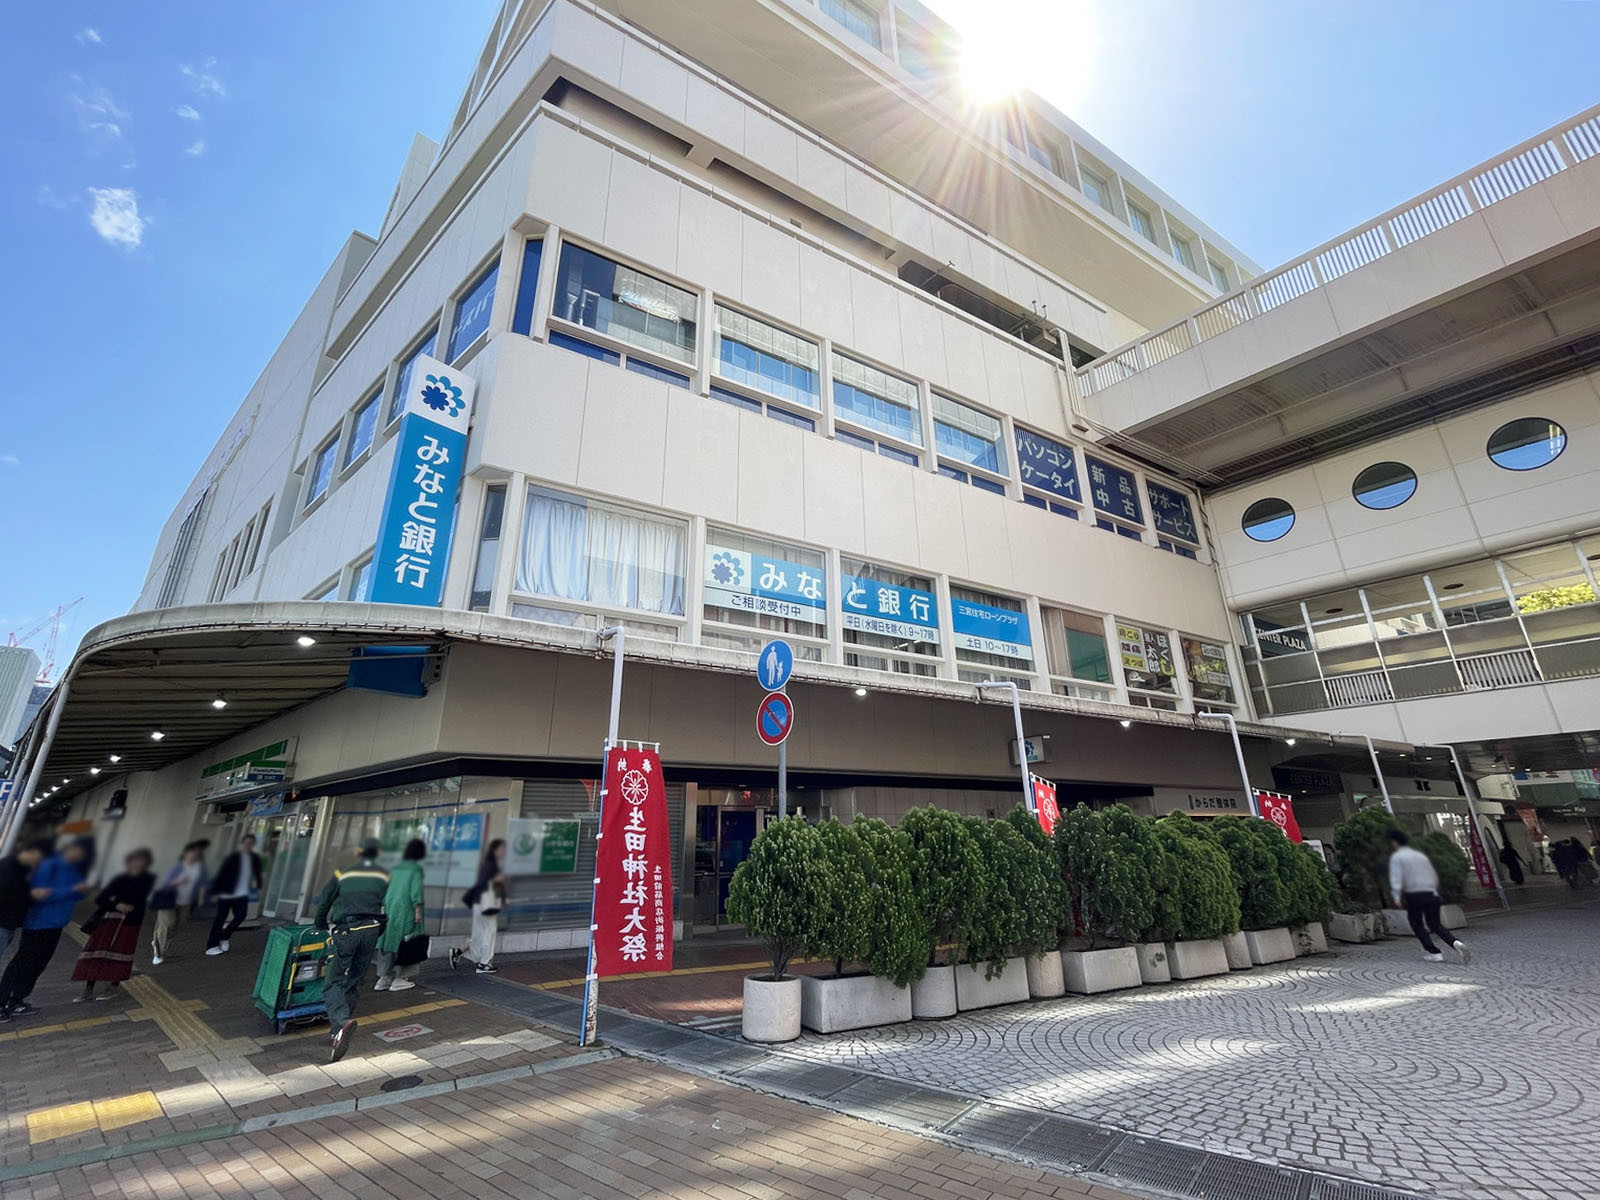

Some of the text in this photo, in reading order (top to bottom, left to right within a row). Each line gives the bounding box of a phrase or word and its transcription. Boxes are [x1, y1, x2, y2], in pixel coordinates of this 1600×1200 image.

[1017, 438, 1072, 469] パソコン
[1021, 461, 1075, 495] ケータイ
[1091, 465, 1132, 495] 新品
[394, 435, 450, 589] みなと銀行
[1096, 489, 1136, 518] 中古
[1148, 488, 1189, 516] サポート
[1153, 512, 1196, 538] サービス
[731, 594, 801, 617] ご相談受付中
[959, 605, 1018, 625] 三宮住宅ローンプラザ
[1282, 635, 1307, 651] PLAZA
